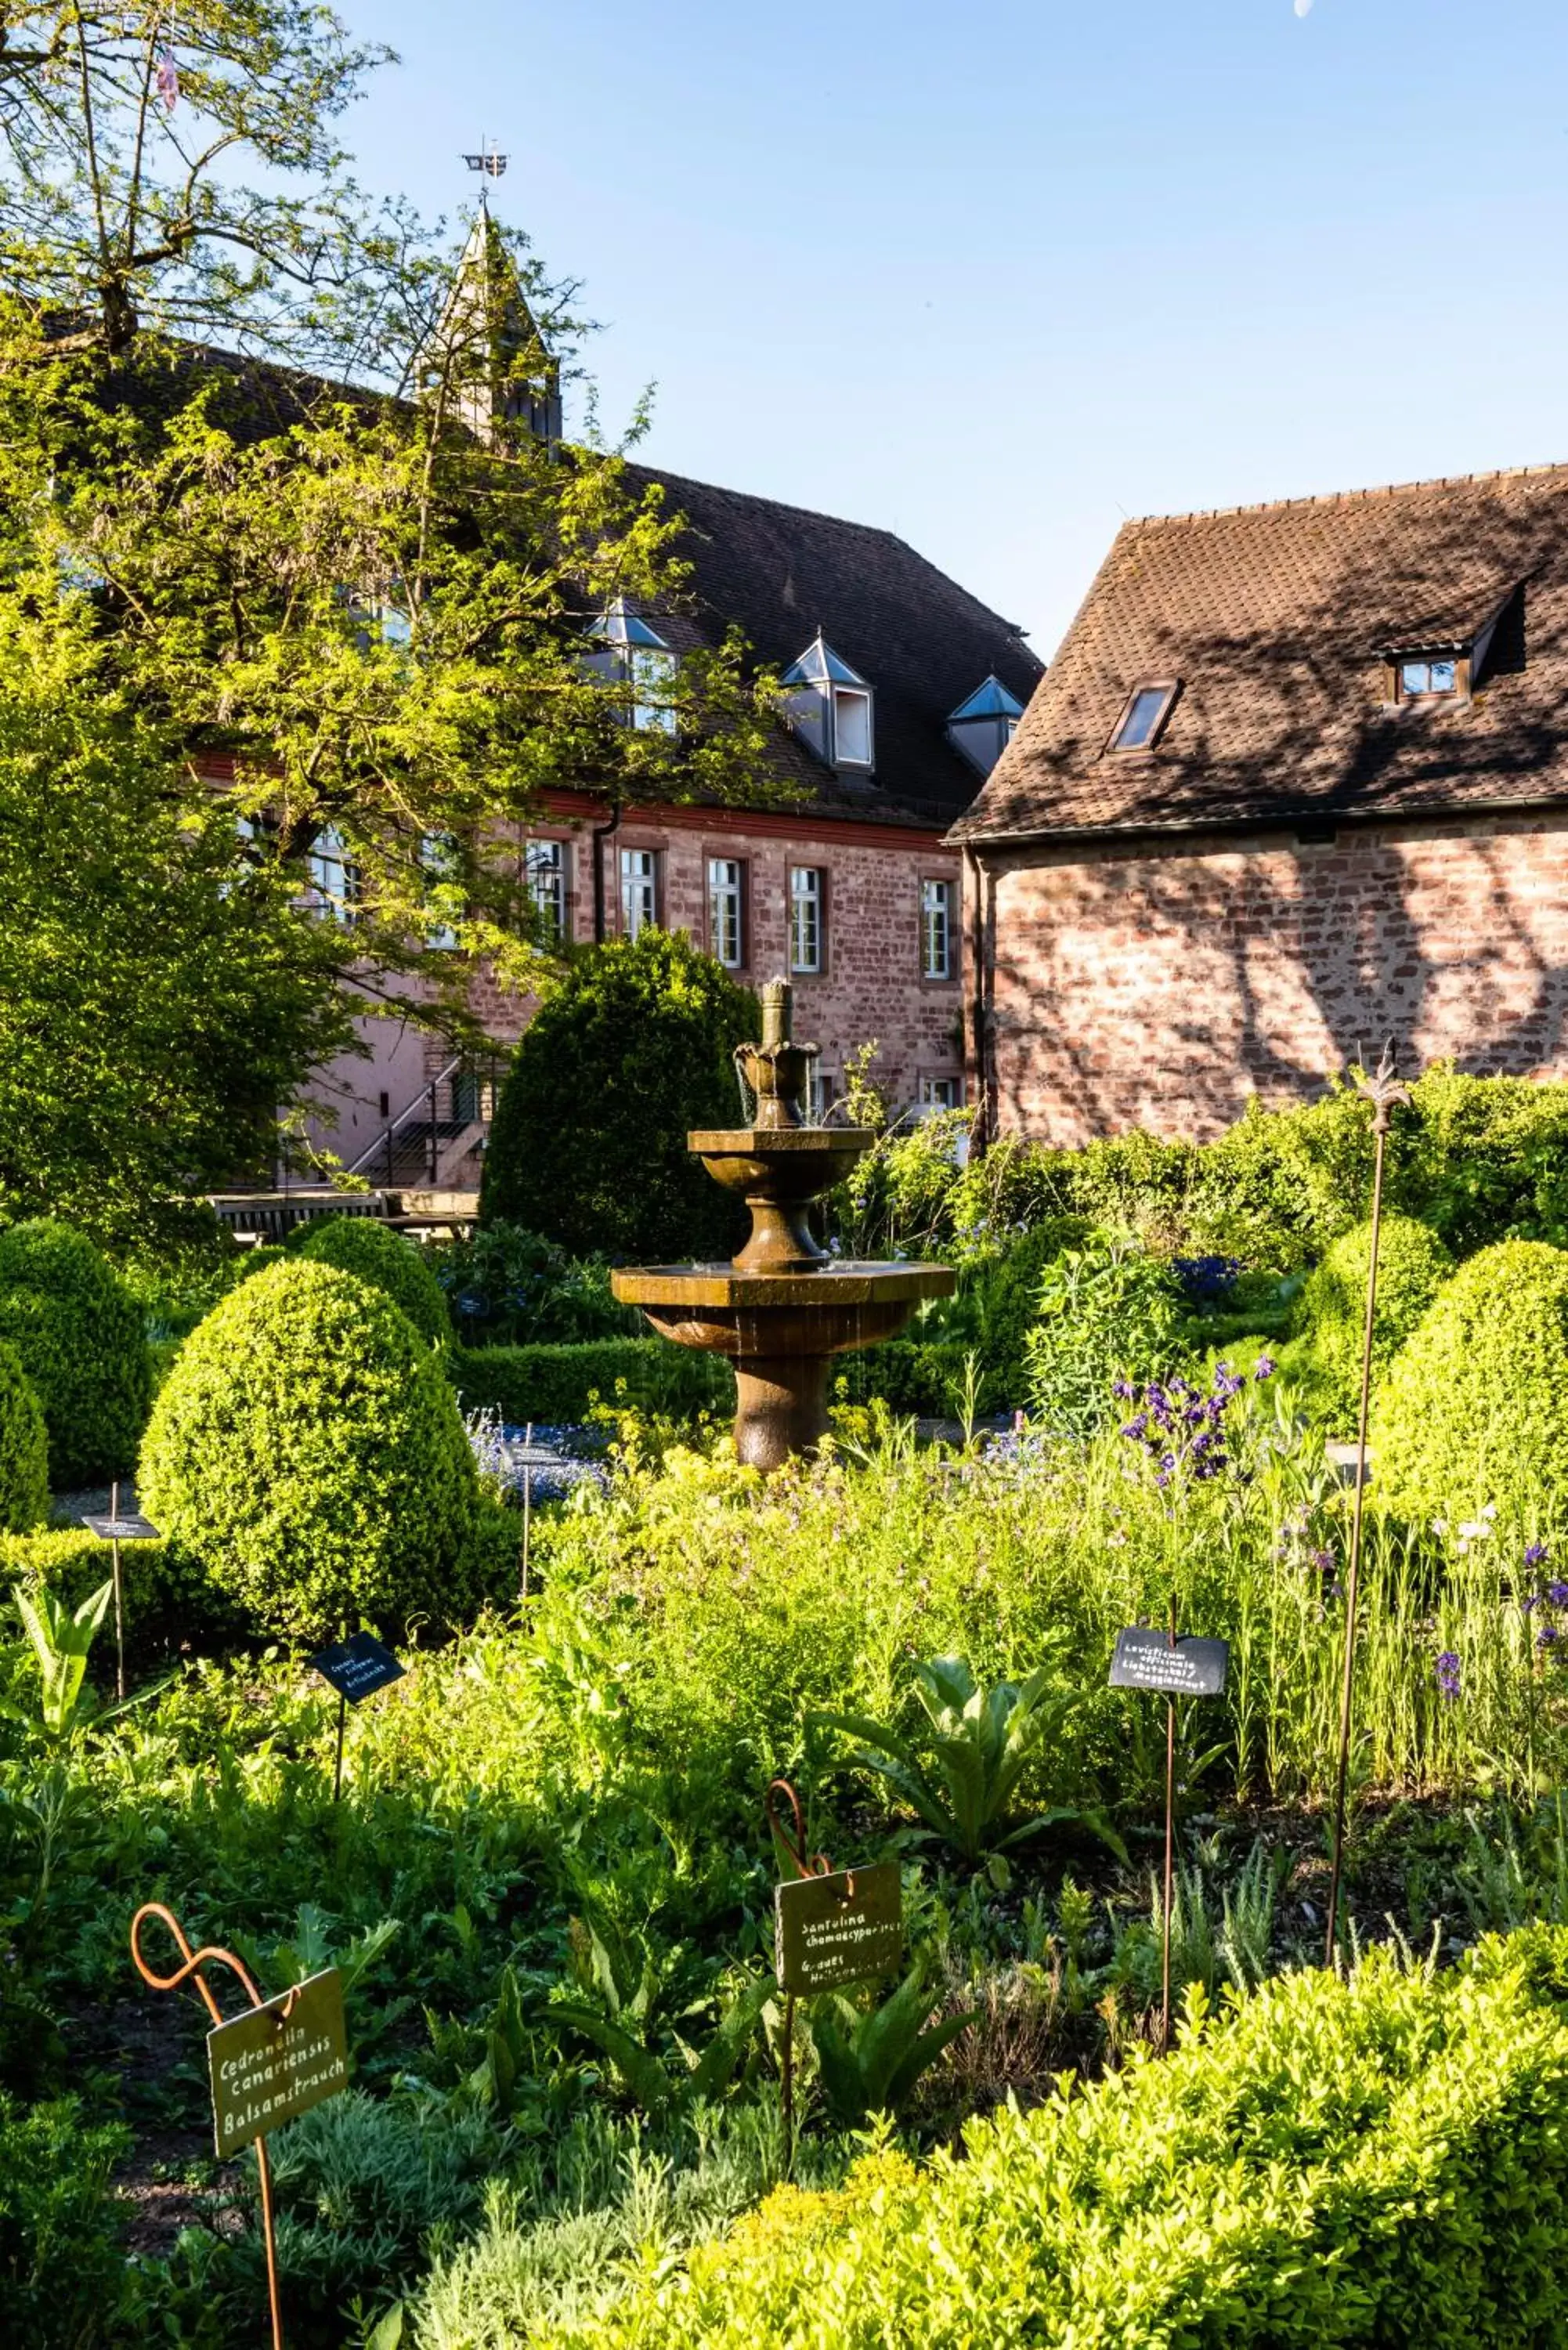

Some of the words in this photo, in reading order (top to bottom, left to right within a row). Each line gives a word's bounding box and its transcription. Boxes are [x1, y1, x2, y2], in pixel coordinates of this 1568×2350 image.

[220, 2026, 305, 2080] Cedronella
[231, 2036, 330, 2095] canariensis
[224, 2056, 344, 2135] Balsamstrauch
